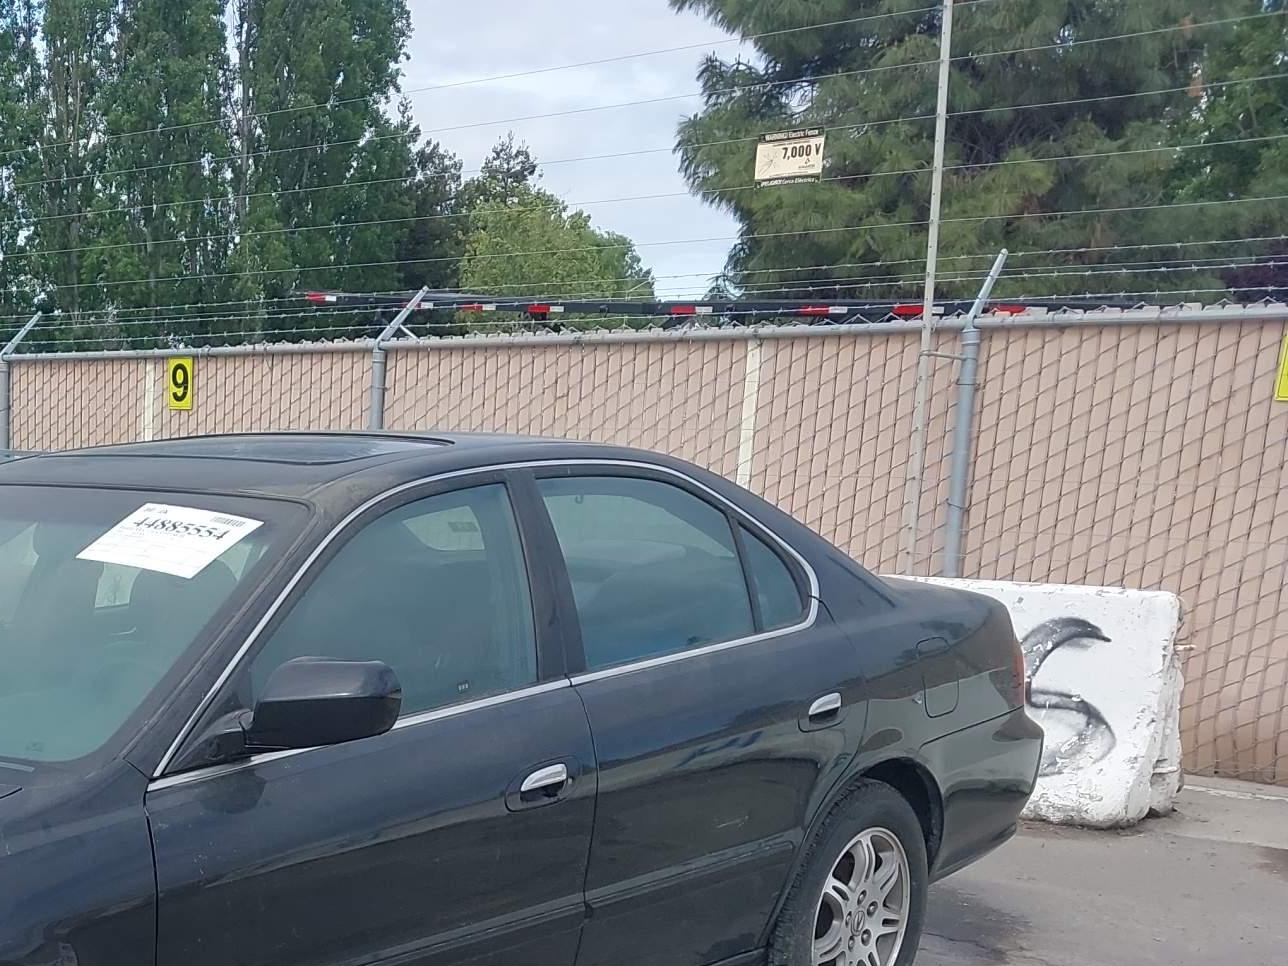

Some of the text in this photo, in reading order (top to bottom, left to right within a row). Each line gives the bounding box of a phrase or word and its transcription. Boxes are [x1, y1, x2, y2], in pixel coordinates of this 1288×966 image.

[782, 144, 811, 160] 7,000
[815, 143, 821, 155] V
[172, 363, 188, 402] 9
[133, 516, 230, 540] 44885554
